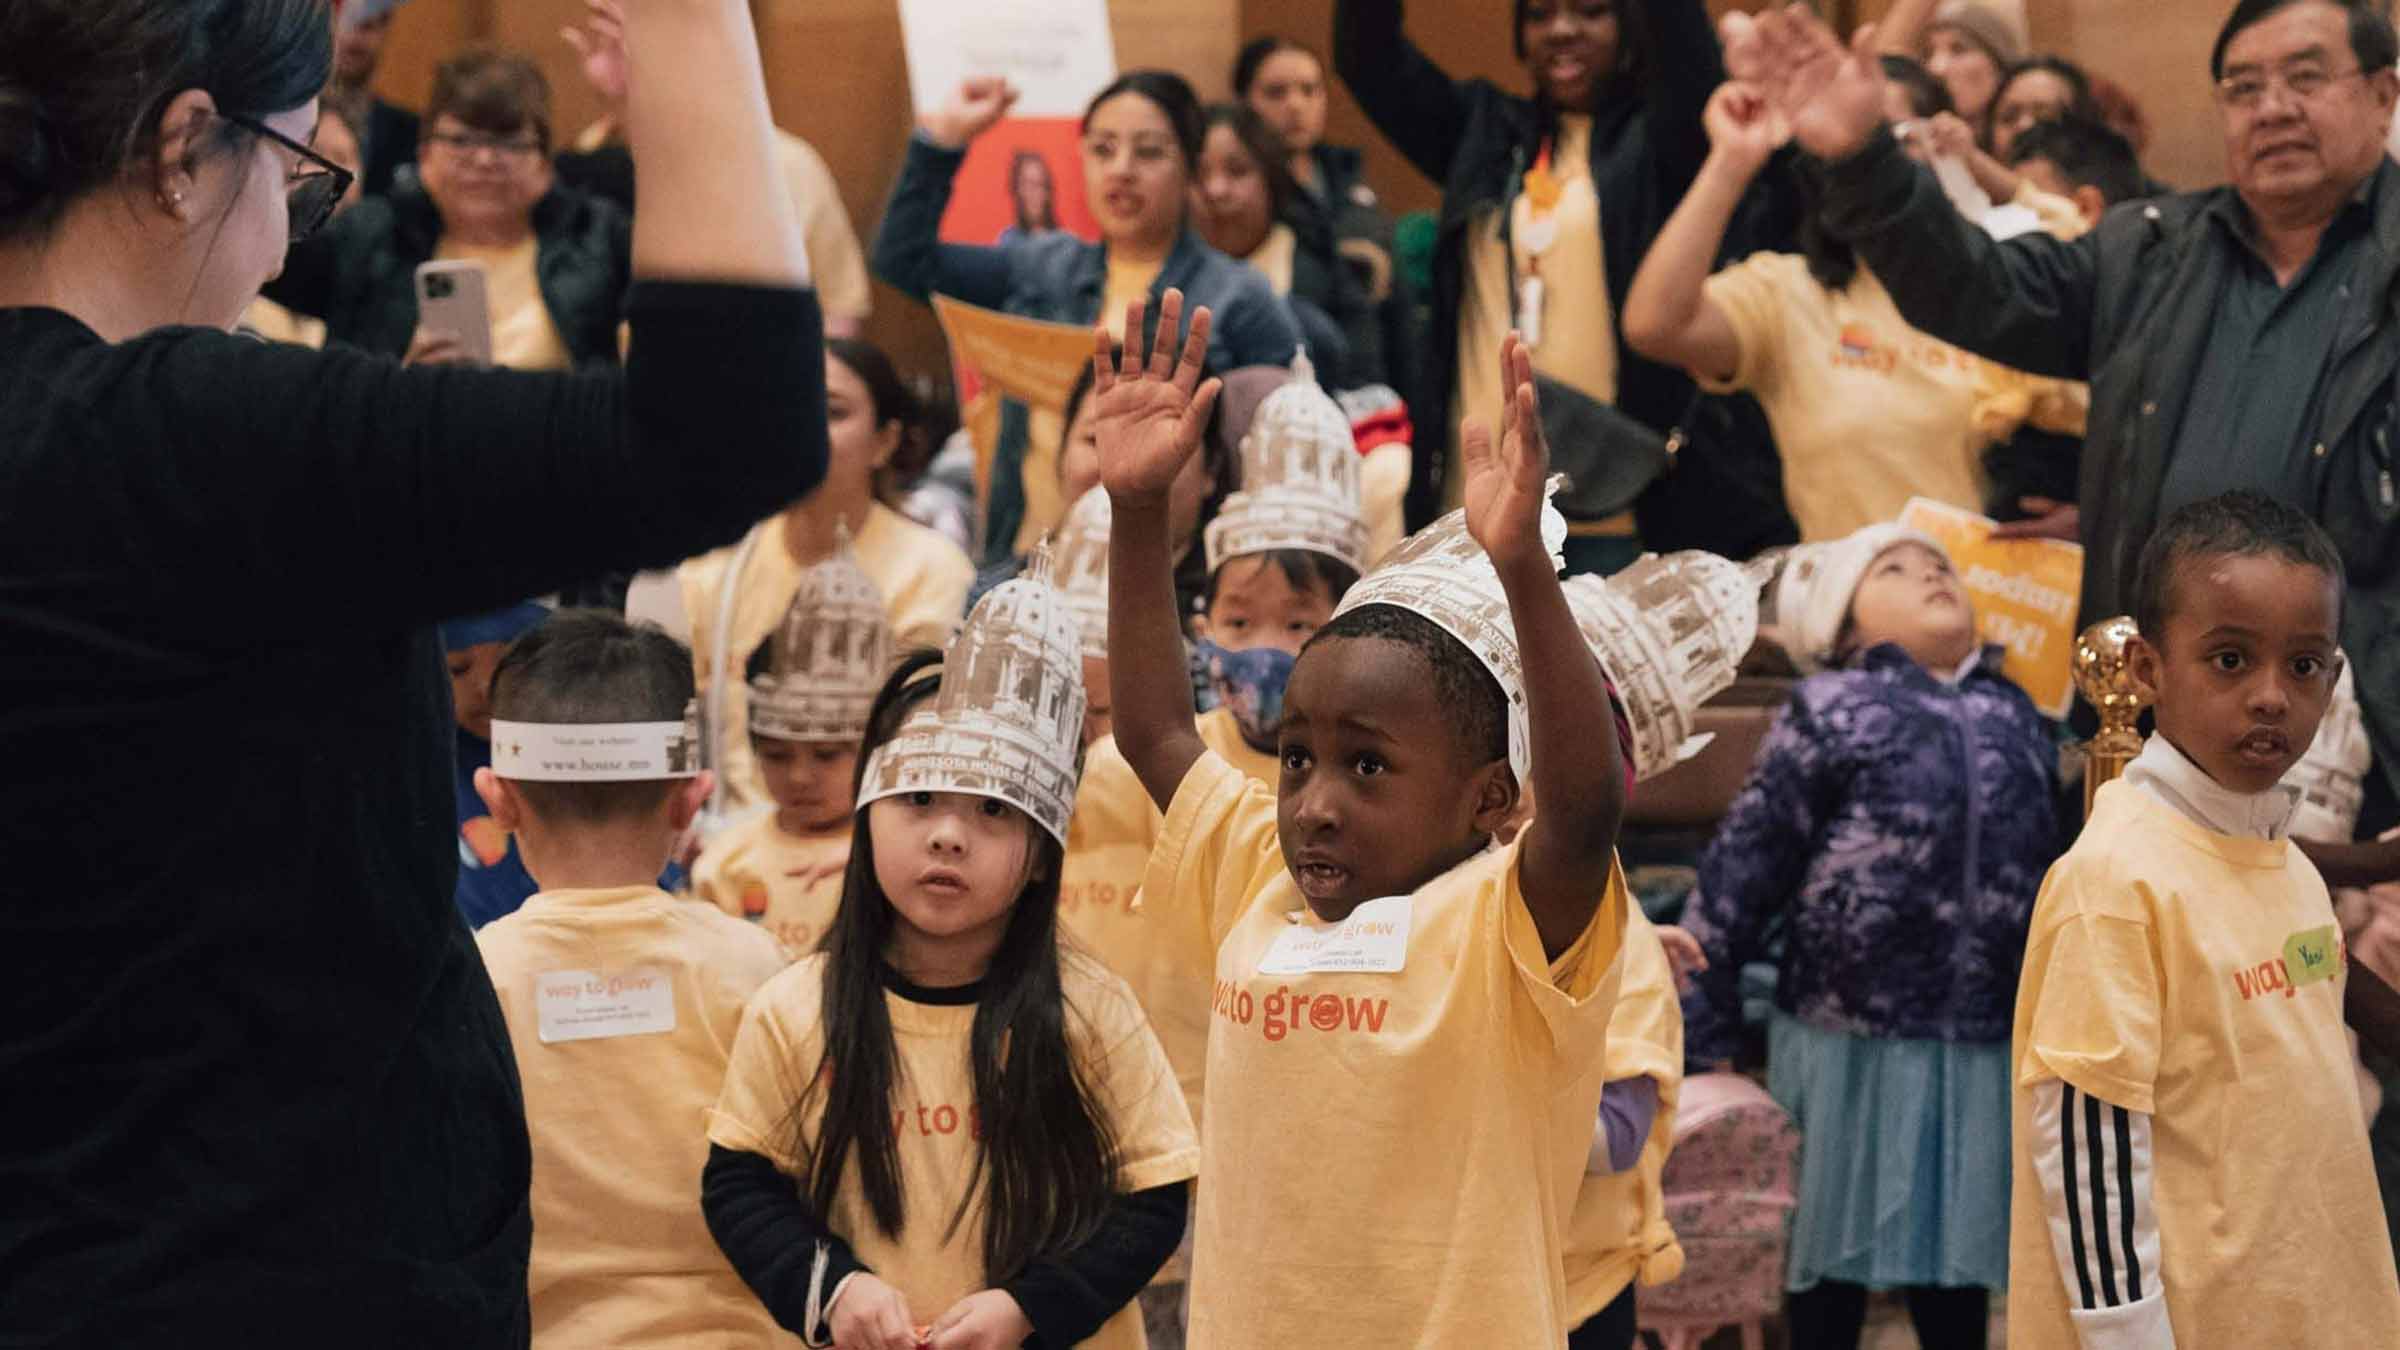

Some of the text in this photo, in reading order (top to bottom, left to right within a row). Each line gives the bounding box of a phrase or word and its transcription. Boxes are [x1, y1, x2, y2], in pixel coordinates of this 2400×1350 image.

[543, 983, 582, 1001] way
[584, 978, 606, 995] to
[2234, 957, 2296, 1001] way
[1262, 983, 1389, 1042] grow
[916, 1101, 961, 1138] to
